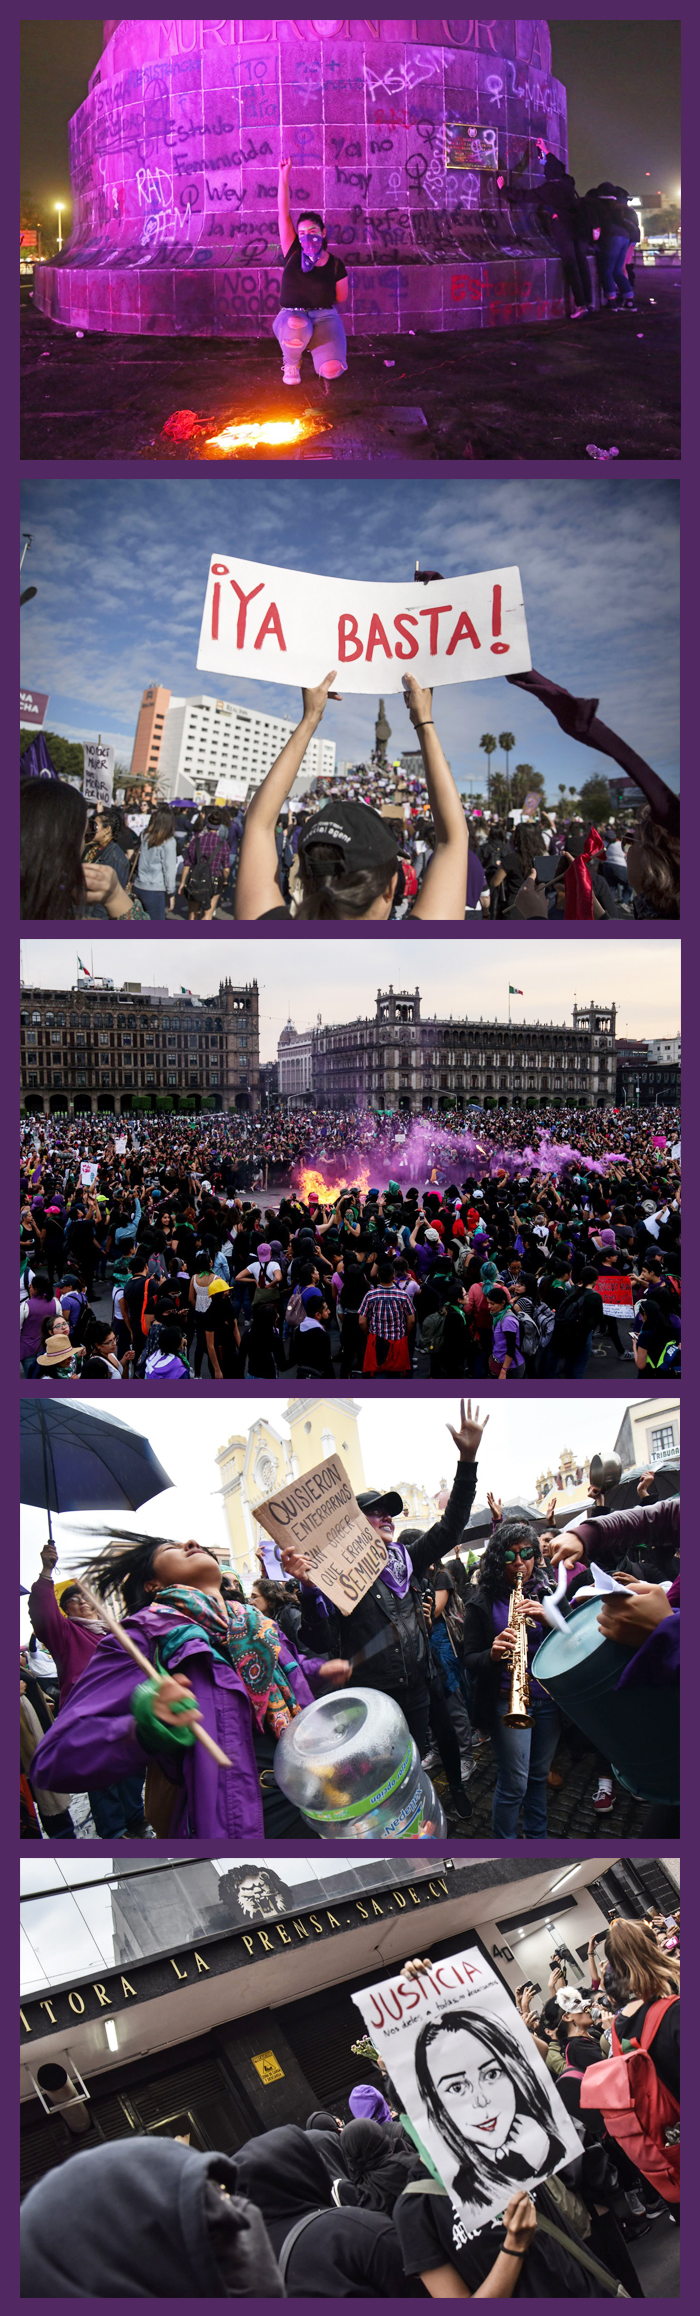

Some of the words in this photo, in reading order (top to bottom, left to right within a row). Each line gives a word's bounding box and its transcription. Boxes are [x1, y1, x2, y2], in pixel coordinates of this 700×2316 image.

[338, 584, 510, 662] BASTA!
[268, 1463, 342, 1526] QUISIERON
[291, 1483, 352, 1542] ENTERRARNOS
[304, 1545, 327, 1570] SIN
[326, 1514, 355, 1549] SABER
[338, 1539, 388, 1602] SEMILLAS
[321, 1562, 344, 1587] QUE
[170, 1951, 210, 1980] LA
[369, 1961, 483, 2030] JUSTICIA
